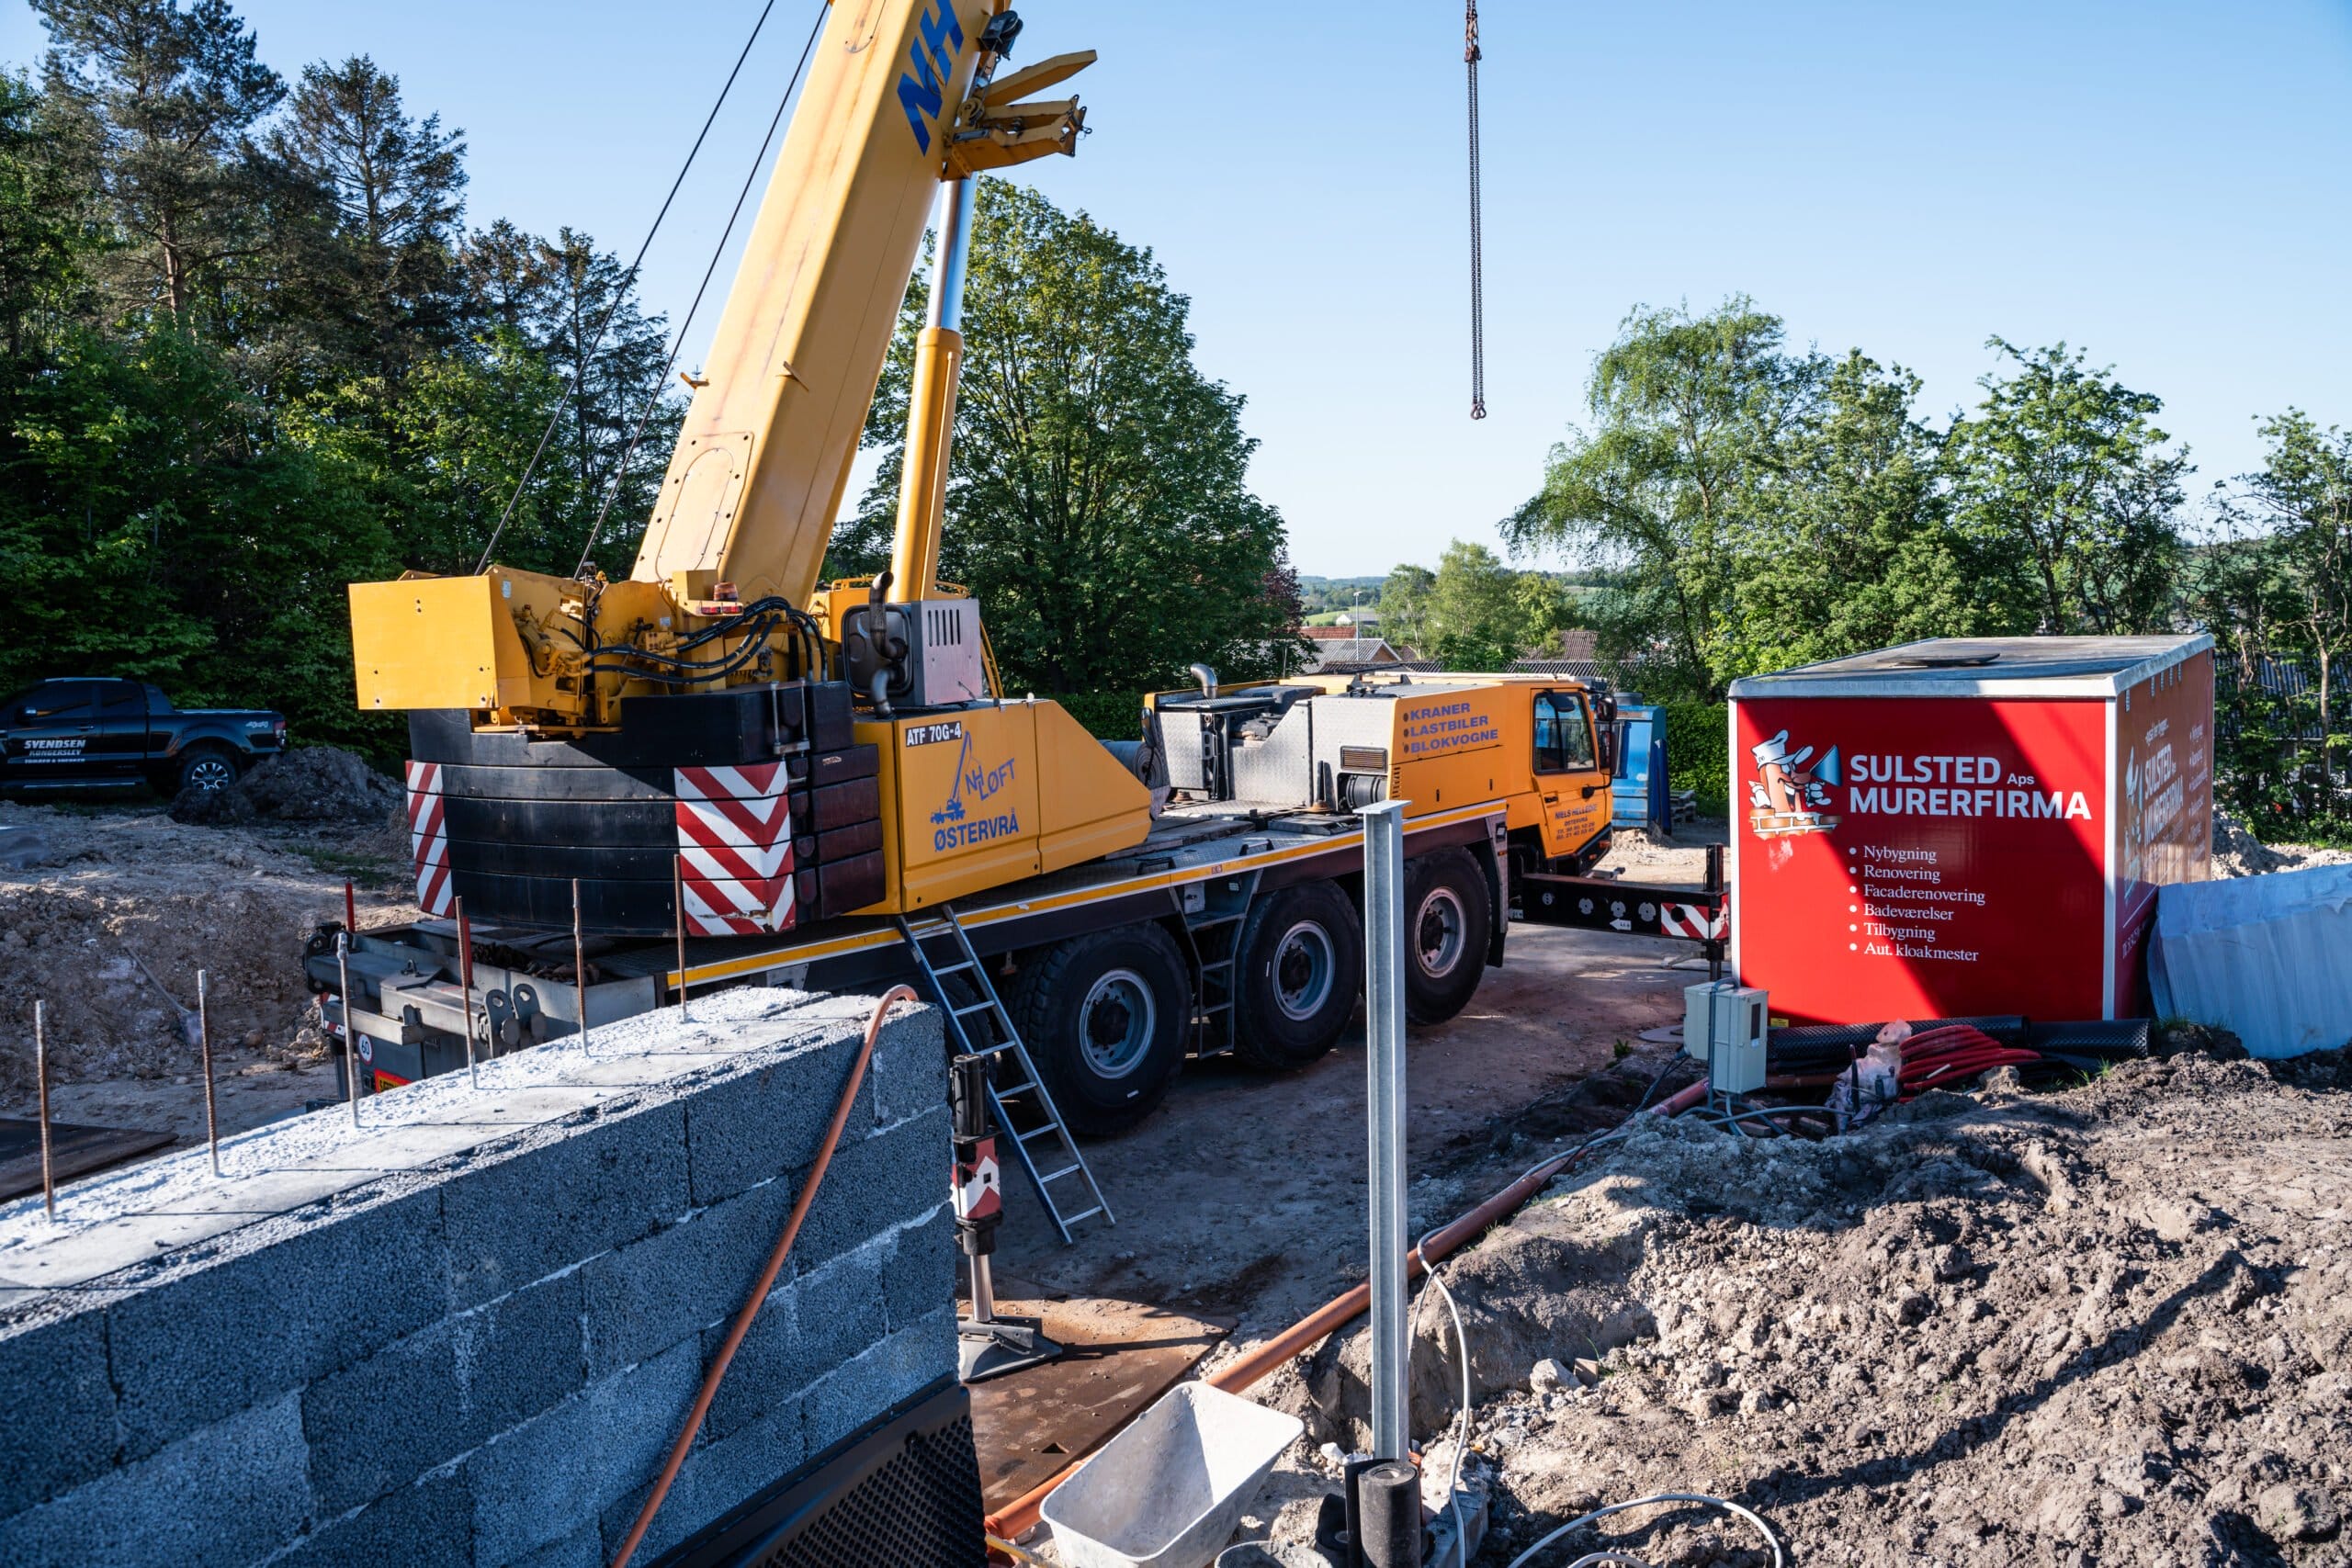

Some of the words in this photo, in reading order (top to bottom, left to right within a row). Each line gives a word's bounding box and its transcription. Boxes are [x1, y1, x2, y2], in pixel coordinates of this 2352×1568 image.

[1410, 703, 1470, 721] KRANER
[906, 727, 926, 746] ATF
[929, 722, 962, 742] 70G-4
[1410, 716, 1488, 737] LASTBILER
[24, 739, 86, 750] SVENDSEN
[1410, 728, 1498, 753] BLOKVOGNE
[1850, 754, 2001, 784] SULSTED
[2007, 773, 2035, 787] Aps
[1849, 786, 2092, 819] MURERFIRMA
[934, 807, 1019, 852] ØSTERVRÅ
[1863, 845, 1937, 863] Nybygning
[1863, 864, 1941, 884] Renovering
[1863, 884, 1985, 906] Facaderenovering
[1863, 903, 1954, 920] Badeværelser
[1863, 922, 1936, 942] Tilbygning
[1863, 942, 1893, 955] Aut.
[1895, 943, 1979, 961] kloakmester
[361, 1040, 369, 1055] 60
